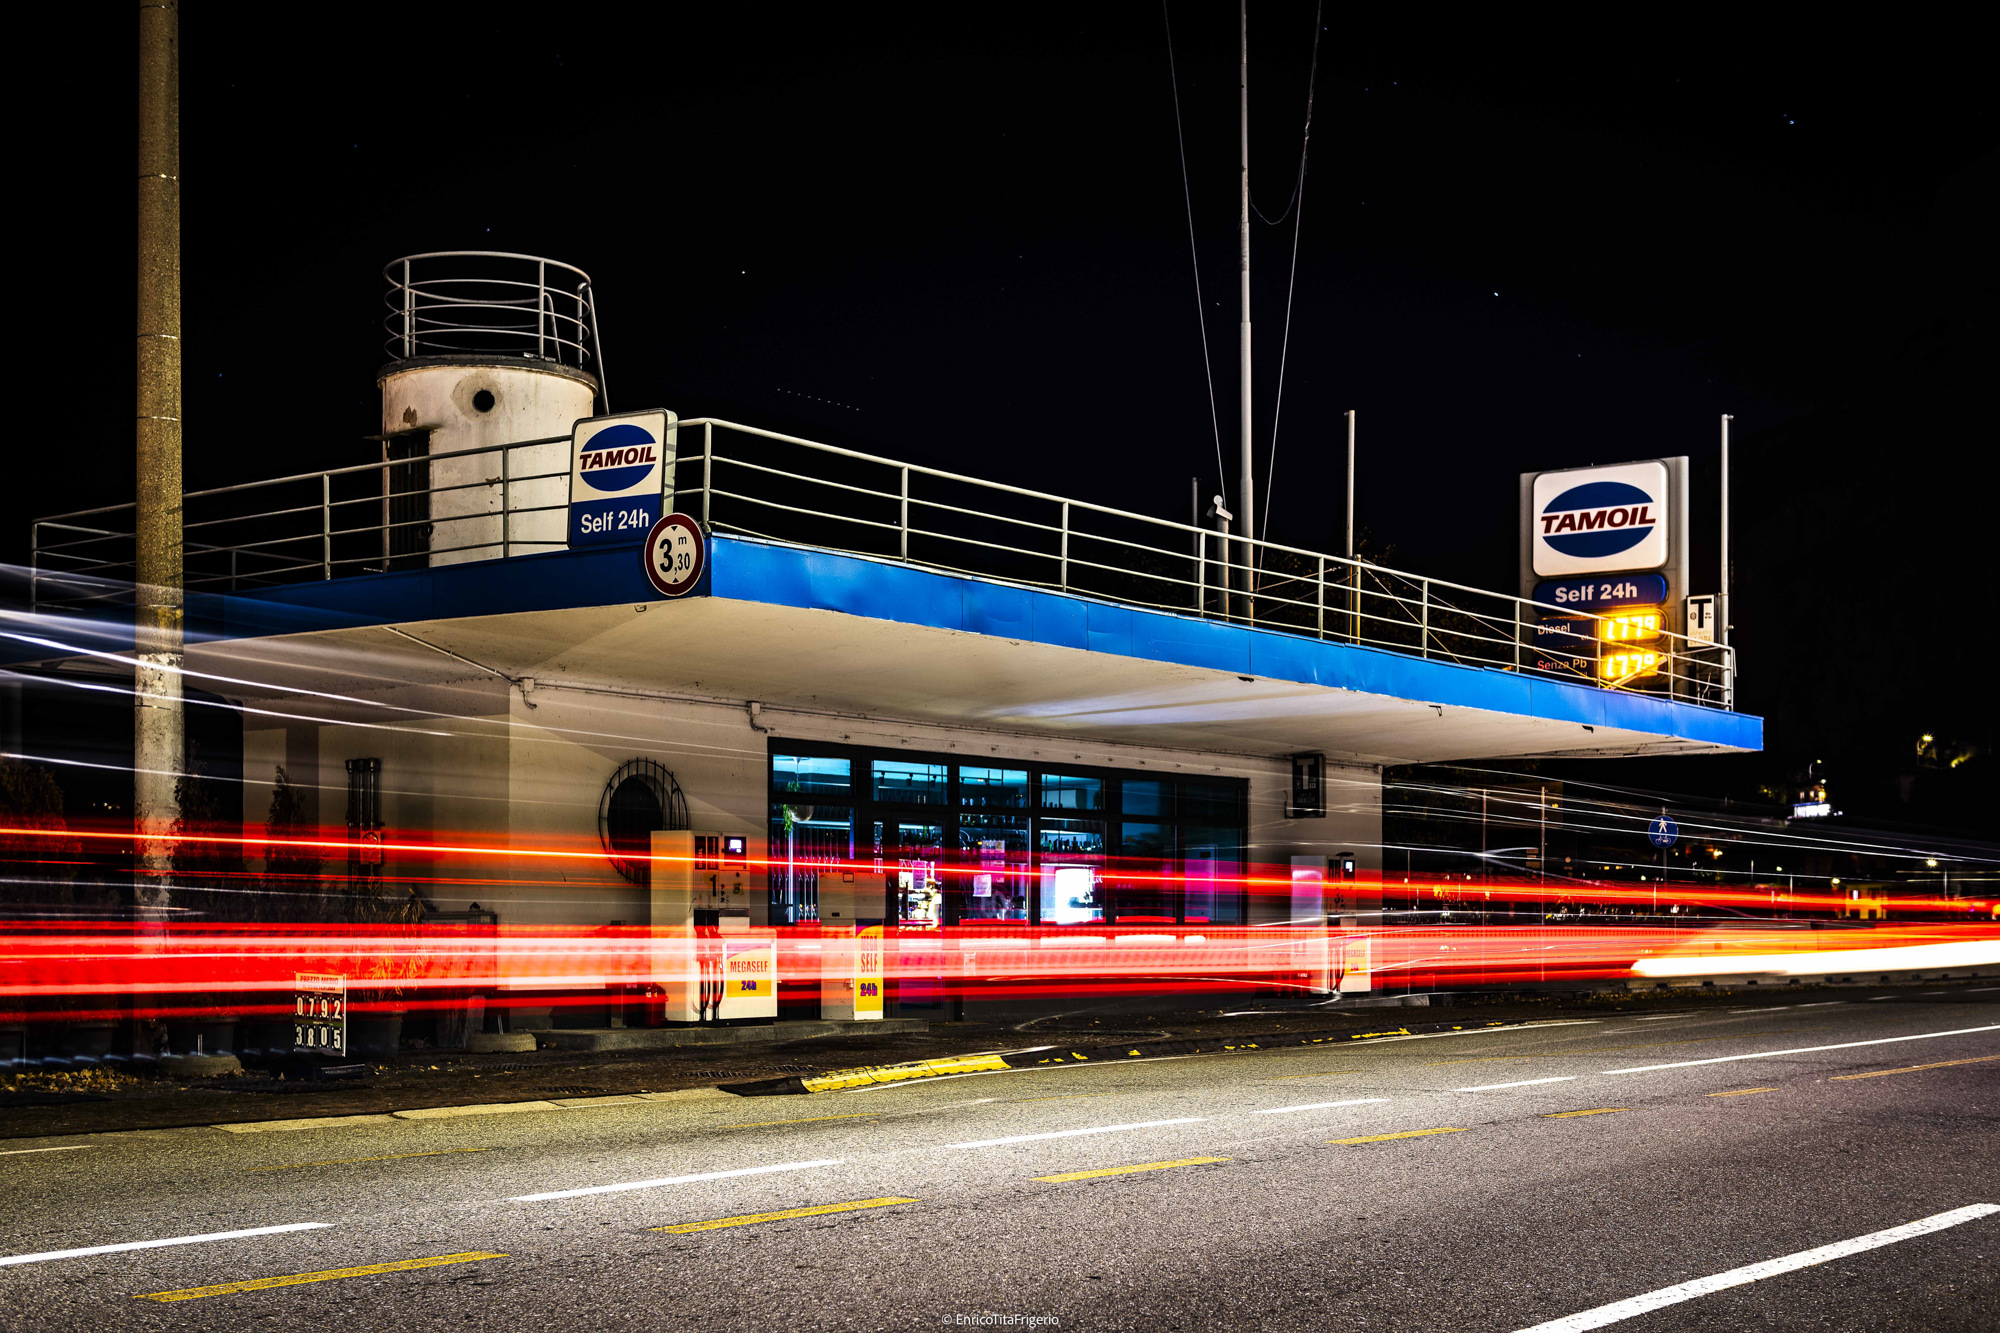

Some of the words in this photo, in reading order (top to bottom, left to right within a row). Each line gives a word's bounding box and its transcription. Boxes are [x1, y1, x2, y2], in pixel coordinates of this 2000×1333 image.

[580, 446, 657, 470] TAMOIL
[581, 511, 613, 534] Self
[618, 508, 649, 530] 24h
[1541, 506, 1656, 534] TAMOIL
[678, 536, 686, 545] m
[1555, 585, 1594, 603] Self
[1600, 582, 1637, 600] 24h
[1690, 598, 1712, 628] T
[1538, 622, 1570, 635] Diesel
[1537, 660, 1569, 670] Senza
[1573, 658, 1587, 669] Pb
[1297, 759, 1314, 790] T
[709, 874, 717, 897] 1
[730, 960, 768, 973] MEGASELF
[860, 953, 878, 973] SELF
[741, 980, 757, 991] 24h
[860, 982, 878, 997] 24h
[297, 997, 341, 1019] 0792
[296, 1026, 341, 1049] 3805
